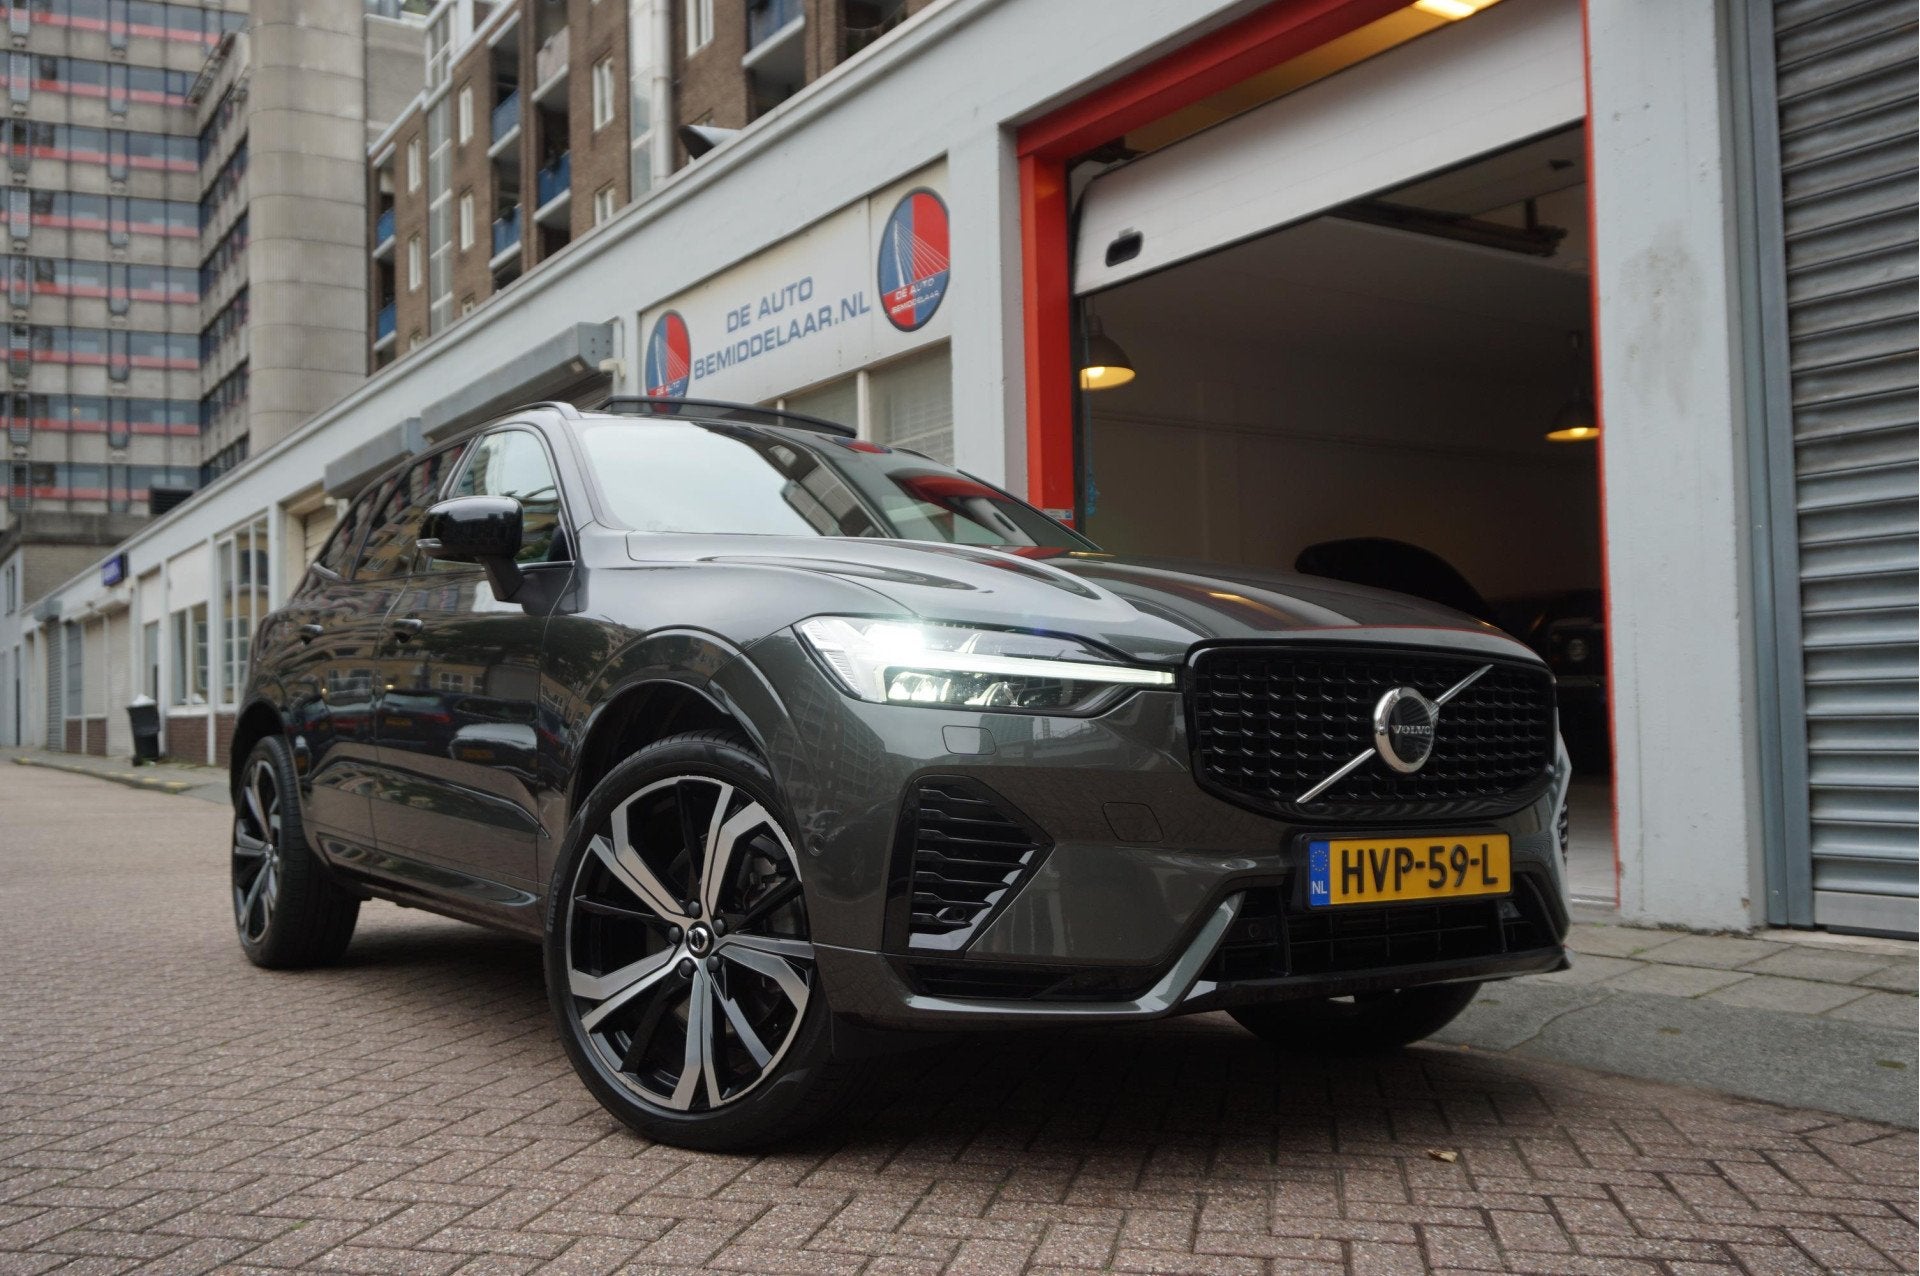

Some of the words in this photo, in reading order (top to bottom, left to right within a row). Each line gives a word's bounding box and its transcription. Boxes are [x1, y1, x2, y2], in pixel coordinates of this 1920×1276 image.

[727, 303, 752, 333] DE
[757, 276, 814, 320] AUTO
[895, 288, 908, 301] DE
[909, 277, 936, 294] AUTO
[694, 291, 871, 381] BEMIDDELAAR.NL
[1392, 724, 1432, 735] VOLVO
[1312, 880, 1328, 895] NL
[1341, 843, 1498, 895] HVP-59-L
